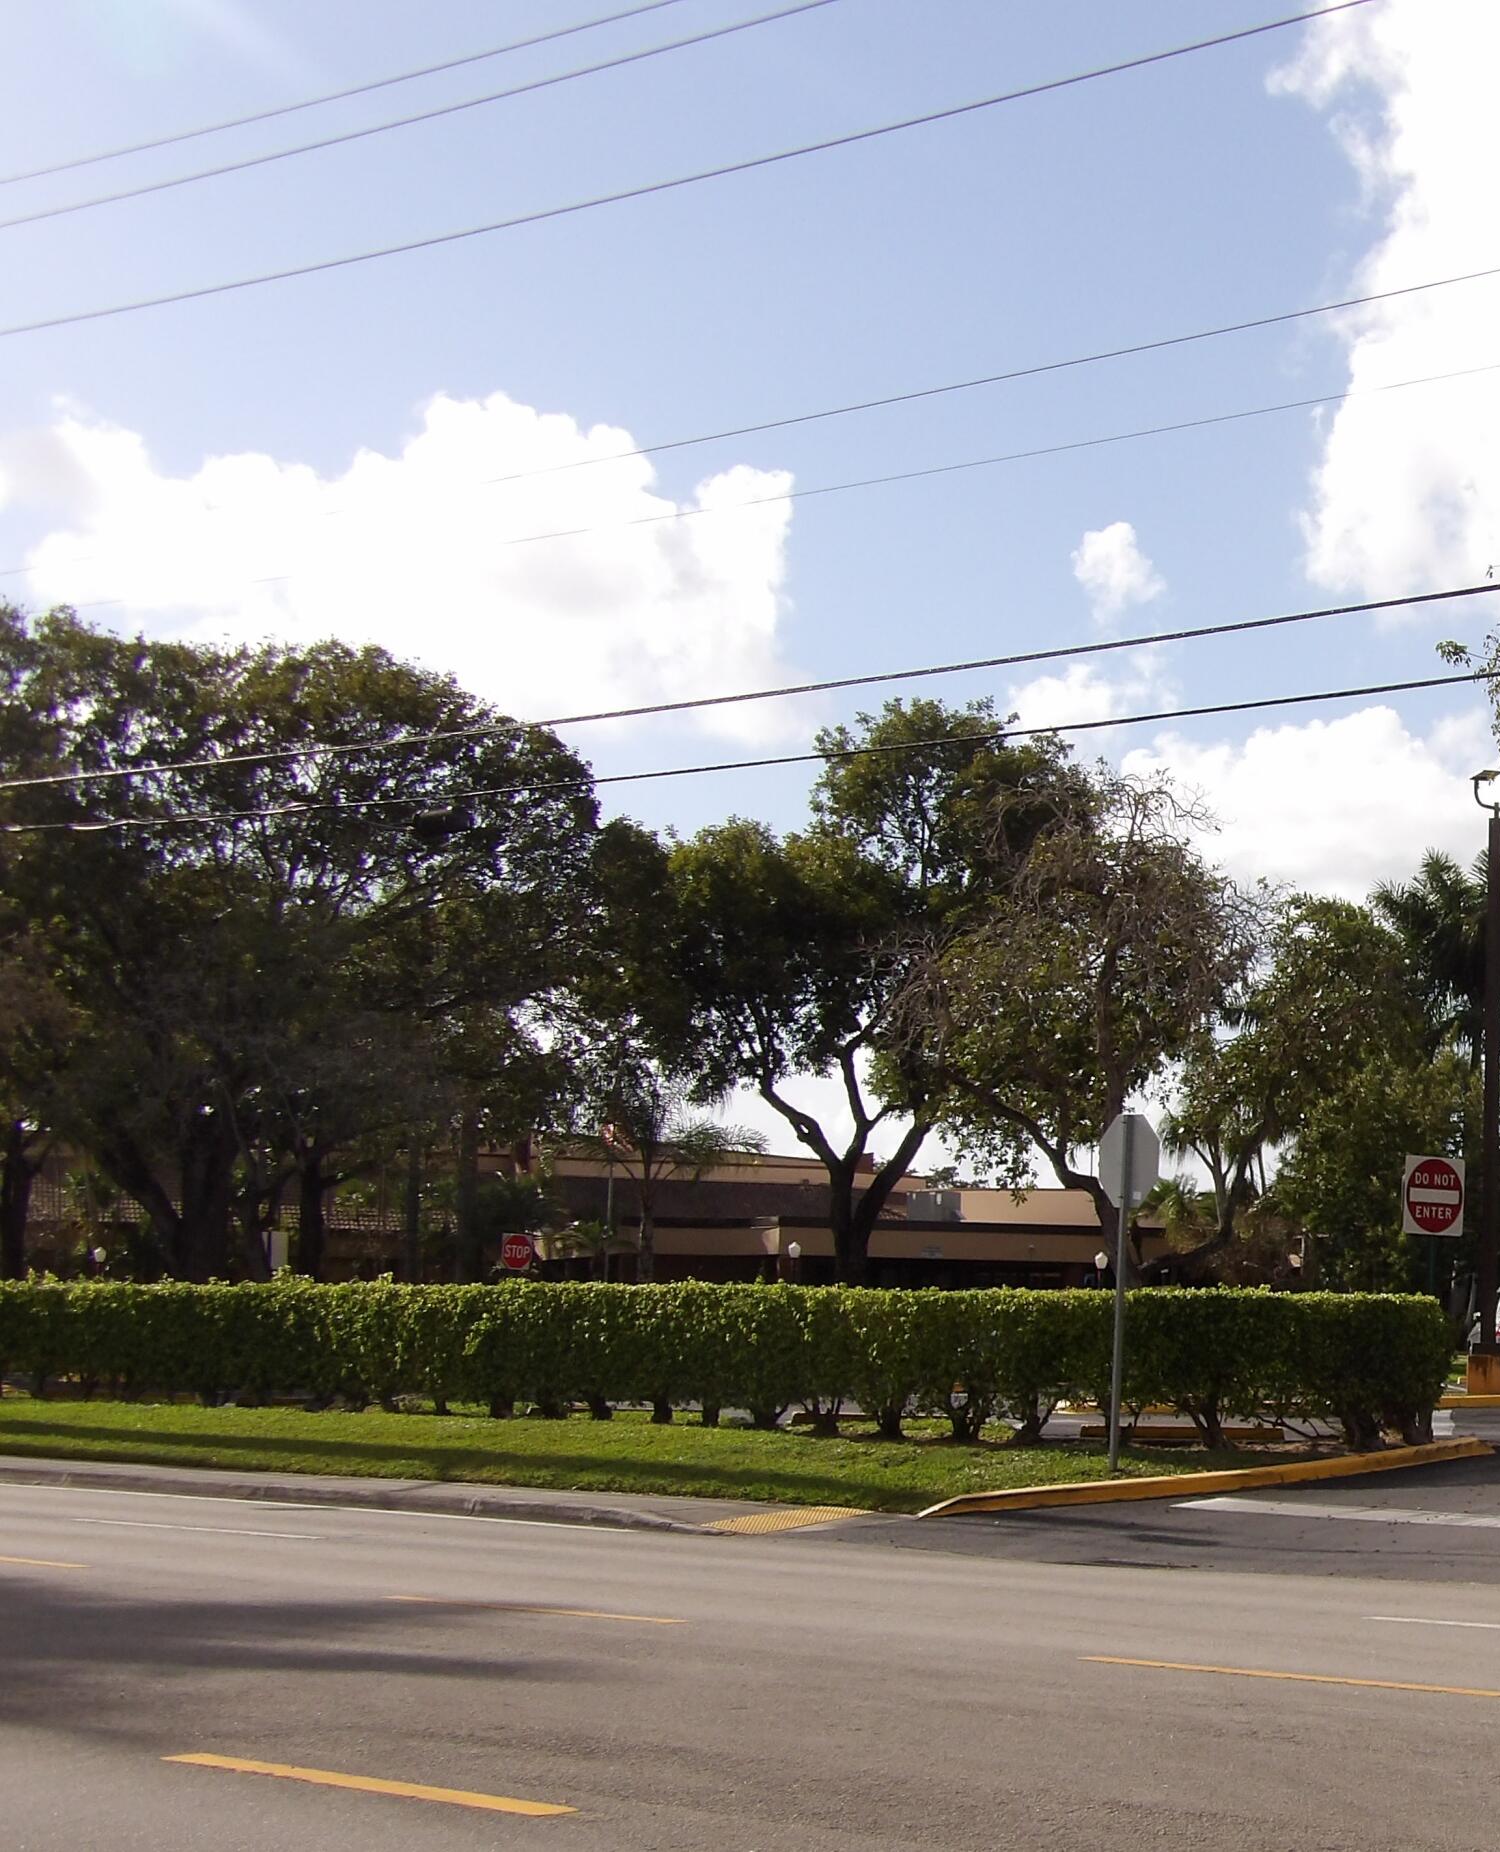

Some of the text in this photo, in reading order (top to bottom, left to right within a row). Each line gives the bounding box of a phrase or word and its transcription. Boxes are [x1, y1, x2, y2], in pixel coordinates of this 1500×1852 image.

[1414, 1171, 1456, 1187] DO NOT
[1415, 1205, 1453, 1220] ENTER
[504, 1244, 531, 1259] STOP
